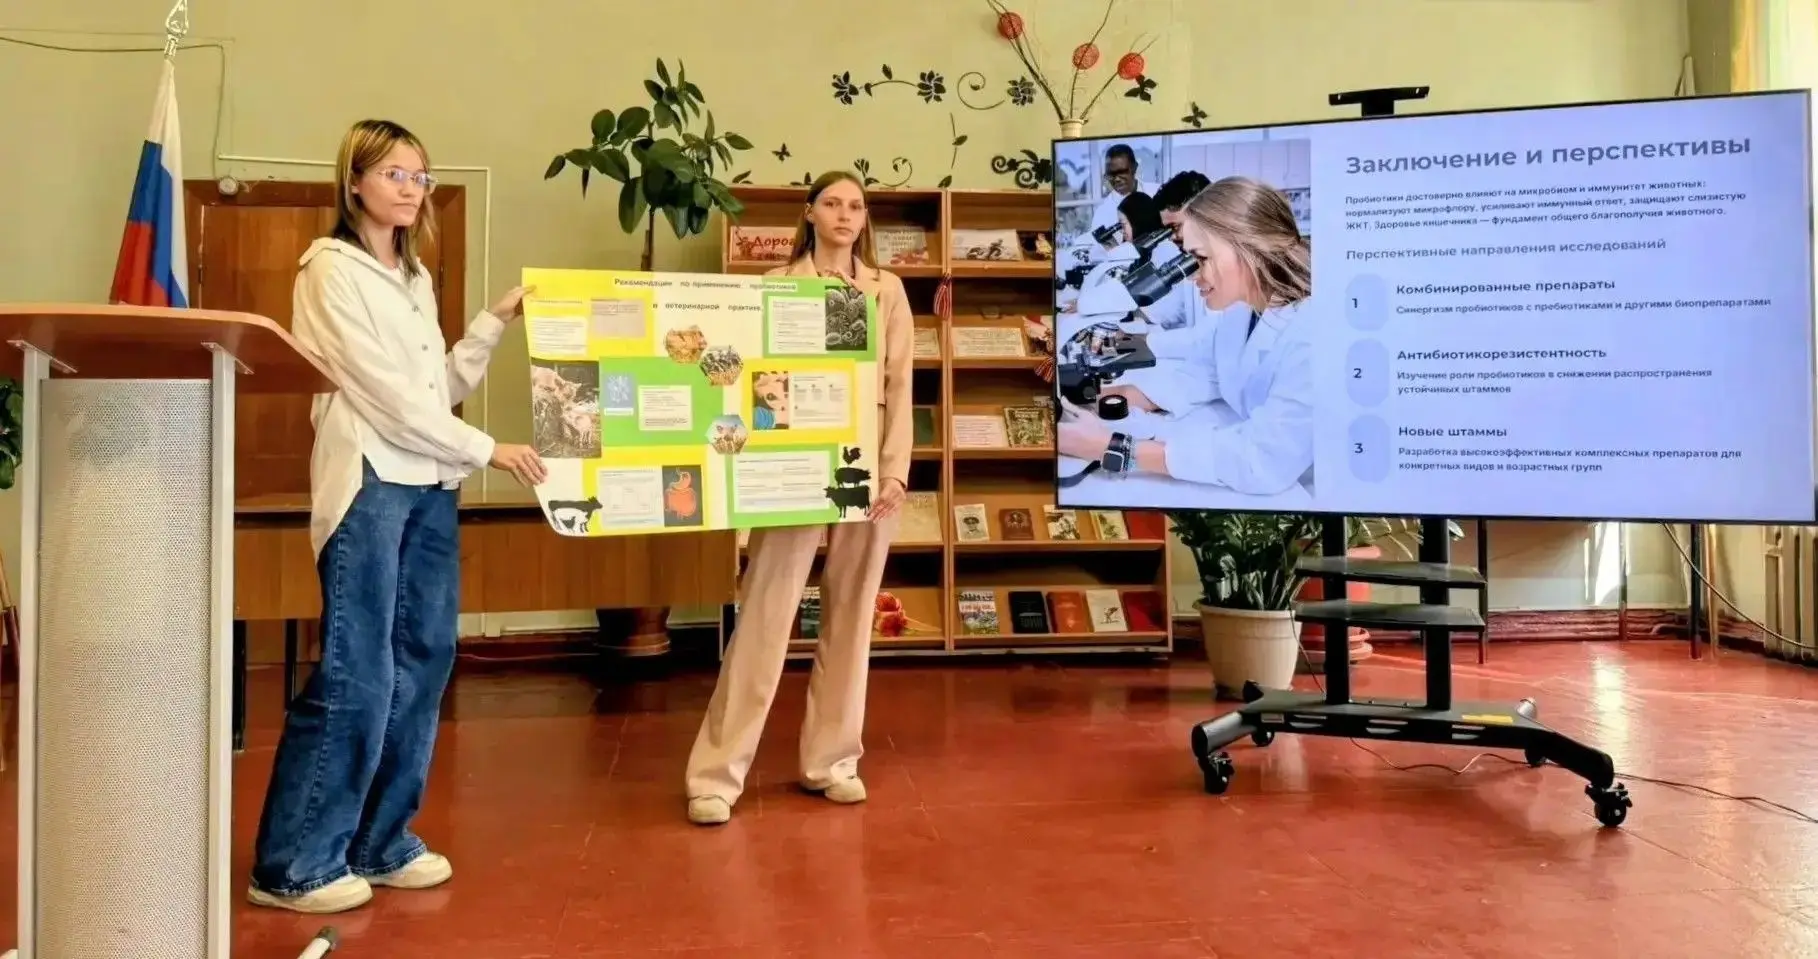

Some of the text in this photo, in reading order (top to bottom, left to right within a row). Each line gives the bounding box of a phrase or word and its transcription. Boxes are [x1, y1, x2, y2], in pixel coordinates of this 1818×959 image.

[1346, 138, 1751, 175] Заключение и перспективы
[1345, 194, 1405, 205] Пробиотики
[1406, 192, 1464, 202] достоверно
[1466, 190, 1502, 198] влияют
[1504, 188, 1516, 196] на
[1518, 186, 1577, 196] микробиом
[1588, 183, 1645, 194] иммунитет
[1345, 207, 1411, 218] нормализуют
[1481, 202, 1534, 212] усиливают
[1537, 199, 1592, 209] иммунный
[1629, 194, 1684, 205] защищают
[1688, 192, 1746, 202] слизистую
[1374, 220, 1421, 230] Здоровье
[1423, 218, 1478, 228] кишечника
[1492, 214, 1548, 226] фундамент
[1551, 212, 1588, 222] общего
[1591, 209, 1663, 220] благополучия
[1346, 238, 1667, 261] Перспективные направления исследований
[1396, 280, 1616, 296] Комбинированные препараты
[1352, 298, 1358, 308] 1
[1396, 305, 1454, 316] Синергизм
[1456, 303, 1524, 314] пробиотиков
[1534, 301, 1614, 312] пребиотиками
[1624, 301, 1672, 311] другими
[1674, 298, 1772, 310] биопрепаратами
[1397, 349, 1607, 362] Антибиотикорезистентность
[1353, 368, 1362, 379] 2
[1397, 371, 1447, 382] Изучение
[1450, 371, 1475, 381] роли
[1476, 370, 1546, 381] пробиотиков
[1556, 370, 1612, 378] снижении
[1614, 369, 1712, 380] распространения
[1398, 384, 1512, 396] устойчивых штаммов
[1399, 427, 1508, 437] Новые штаммы
[1354, 443, 1364, 454] 3
[1398, 447, 1742, 460] Разработка высокоэффективных комплексных препаратов для
[1399, 462, 1461, 472] конкретных
[1463, 462, 1494, 472] видов
[1506, 463, 1569, 474] возрастных
[1571, 464, 1602, 474] групп
